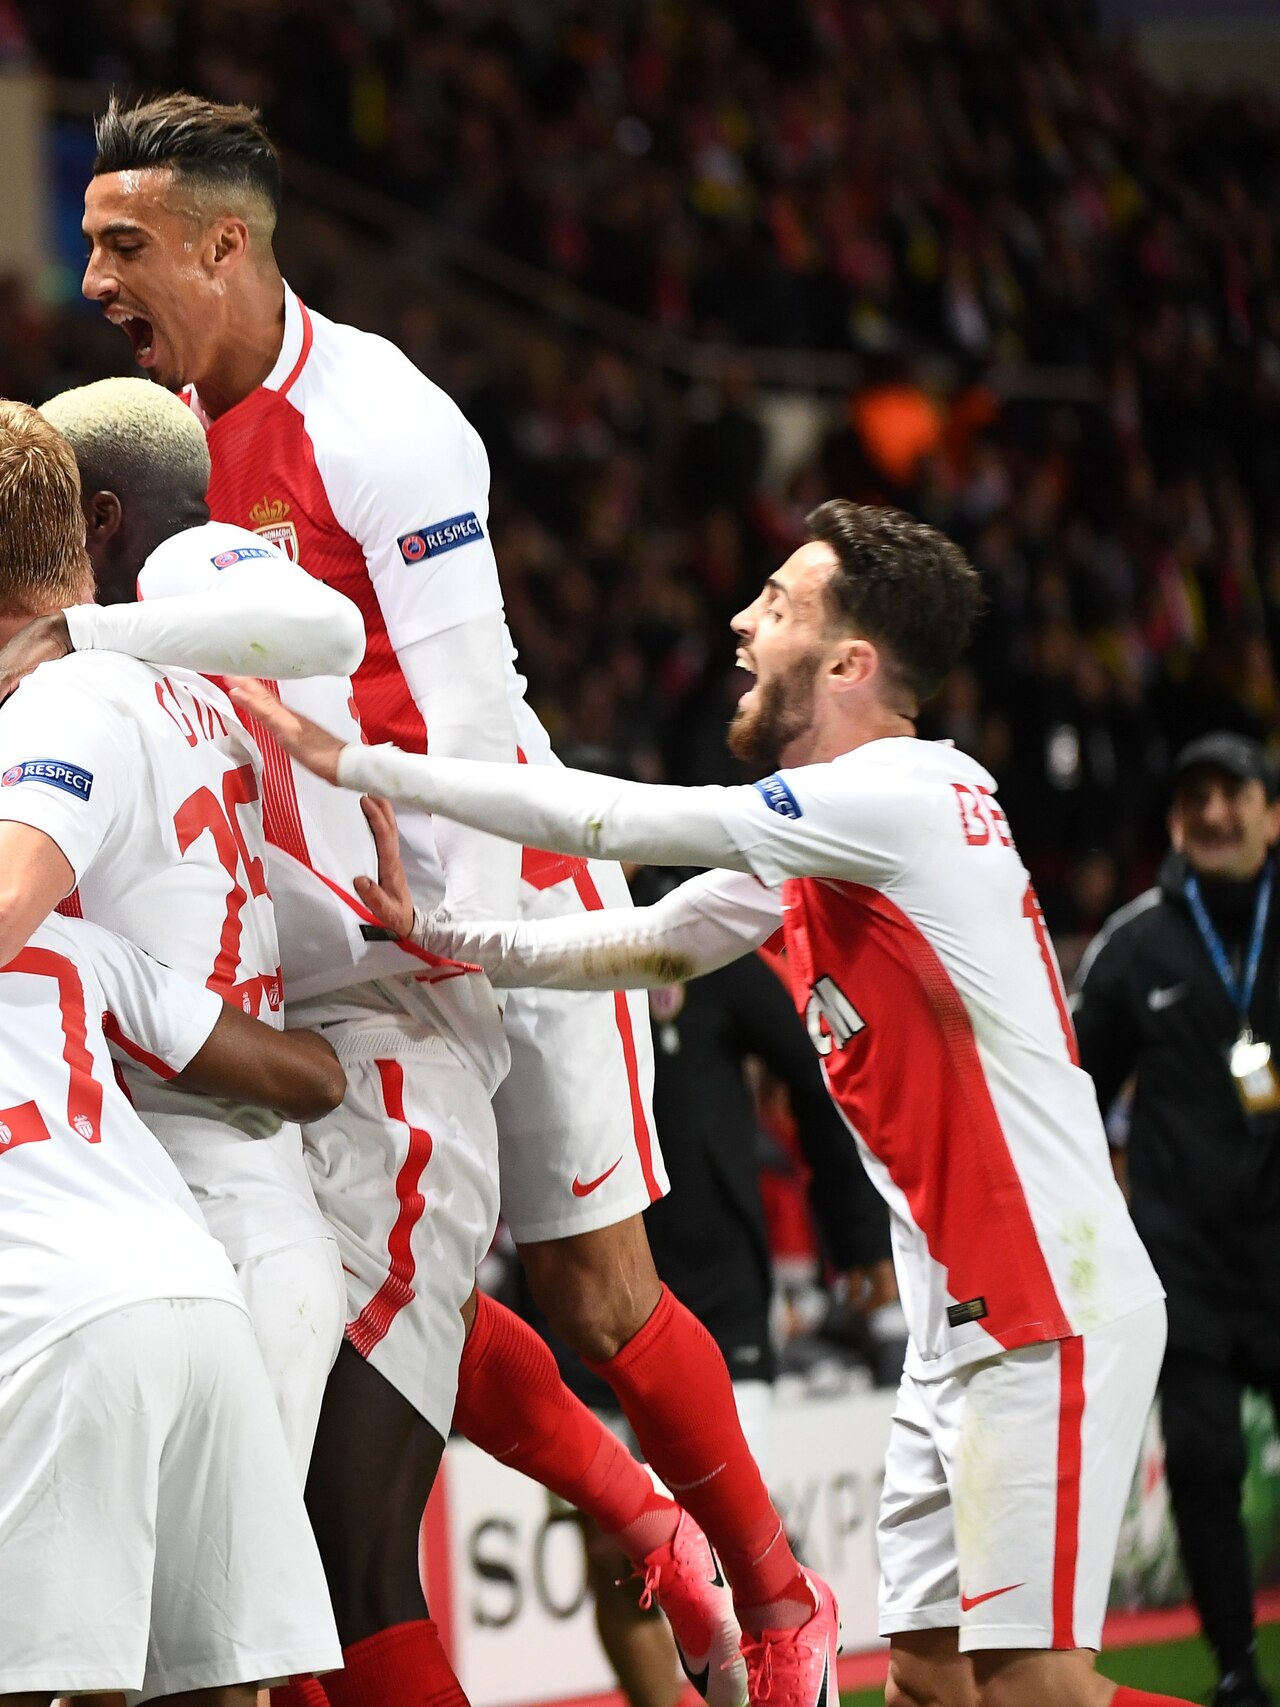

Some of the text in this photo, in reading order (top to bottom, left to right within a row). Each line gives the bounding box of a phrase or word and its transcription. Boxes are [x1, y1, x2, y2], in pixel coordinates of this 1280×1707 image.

[426, 518, 480, 549] RESPECT
[24, 765, 92, 792] RESPECT
[951, 783, 1014, 846] BE
[468, 1517, 588, 1628] SO
